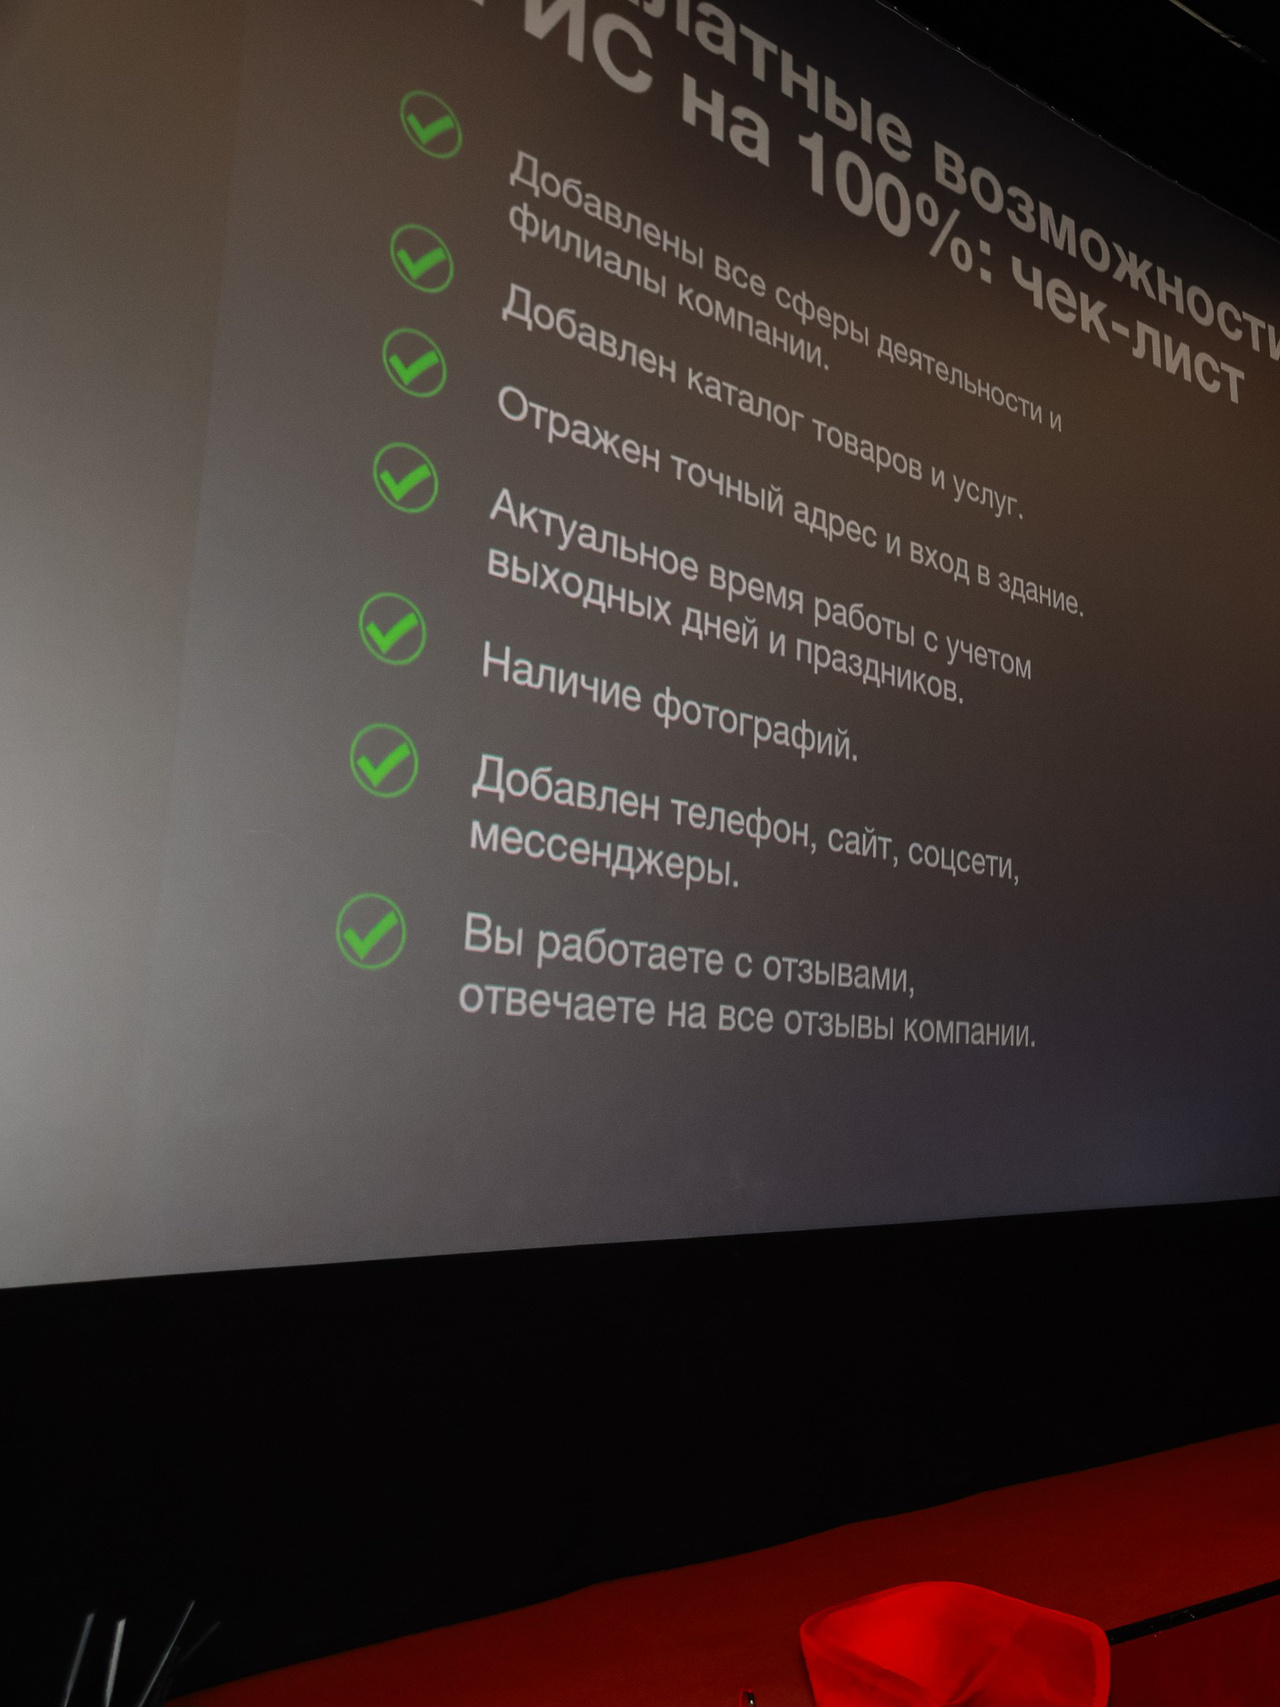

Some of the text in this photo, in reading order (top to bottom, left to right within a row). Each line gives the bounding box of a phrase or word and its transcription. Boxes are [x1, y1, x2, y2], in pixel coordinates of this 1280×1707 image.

[626, 0, 913, 163] латные
[462, 0, 1245, 405] ИС на 100%: чек-лист
[509, 202, 829, 371] филиалы компании.
[509, 150, 1062, 433] Добавлены все сферы деятельности и
[501, 282, 1023, 520] Добавлен каталог товаров и услуг.
[498, 385, 1084, 617] Отражен точный адрес и вход в здание.
[488, 548, 963, 704] выходных дней и праздников.
[489, 487, 1032, 680] Актуальное время работы с учетом
[482, 640, 858, 762] Наличие фотографий.
[470, 819, 739, 891] мессенджеры.
[471, 753, 1019, 886] Добавлен телефон, сайт, соцсети,
[458, 983, 1035, 1047] отвечаете на все отзывы компании.
[464, 911, 914, 999] Вы работаете с отзывами,
